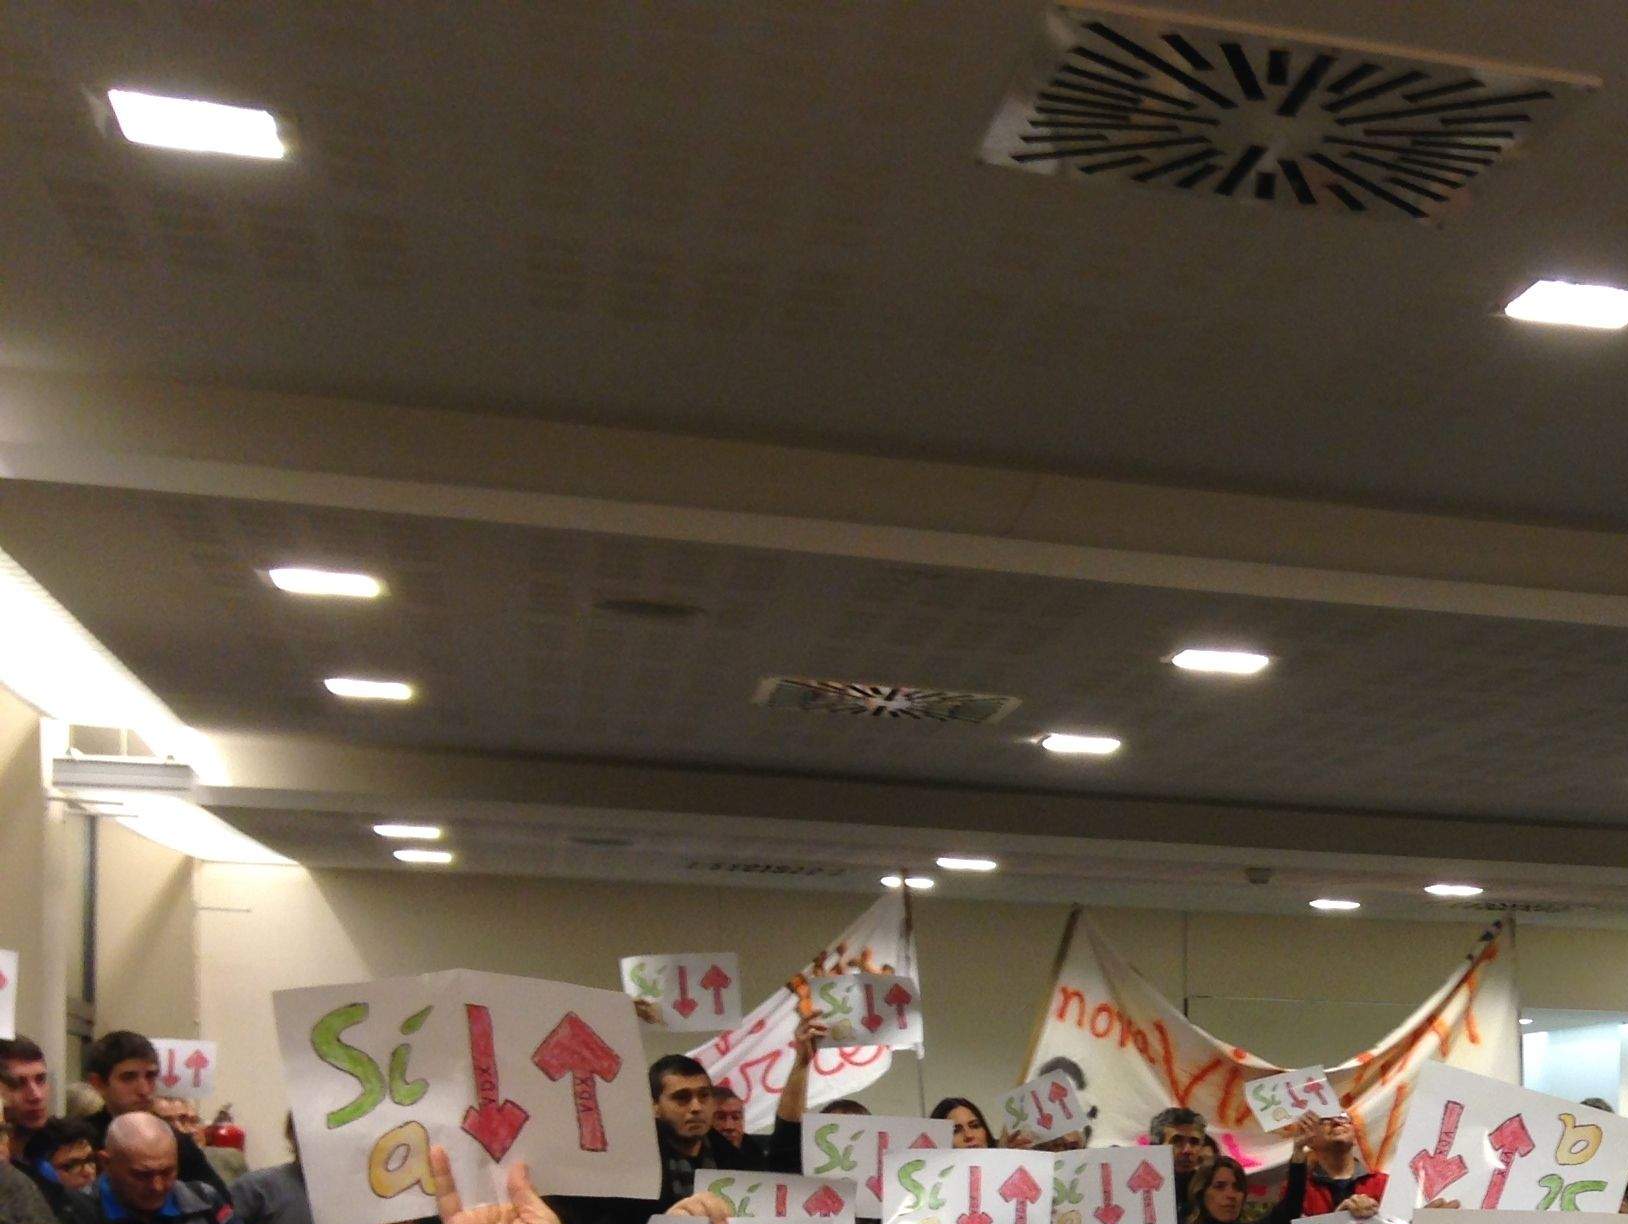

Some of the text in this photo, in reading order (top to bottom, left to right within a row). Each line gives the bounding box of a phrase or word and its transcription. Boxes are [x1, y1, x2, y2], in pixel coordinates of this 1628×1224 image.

[311, 1002, 433, 1129] Sí
[577, 1077, 595, 1113] VDX
[369, 1121, 438, 1199] a
[814, 1122, 866, 1175] Sí
[1555, 1112, 1603, 1166] a
[898, 1159, 954, 1216] Sí
